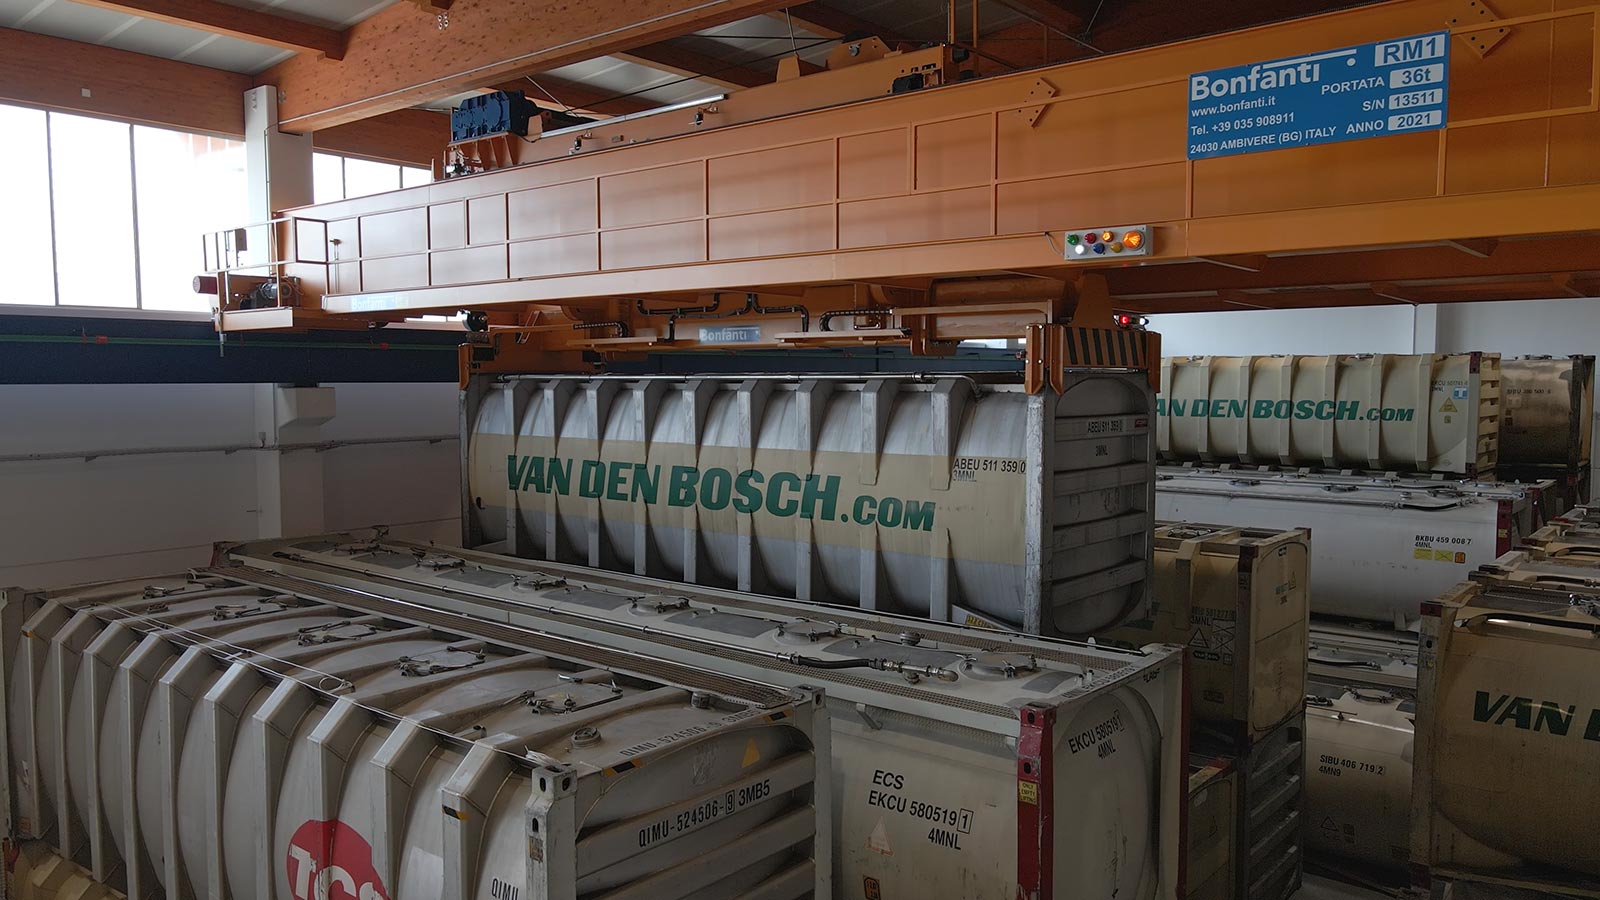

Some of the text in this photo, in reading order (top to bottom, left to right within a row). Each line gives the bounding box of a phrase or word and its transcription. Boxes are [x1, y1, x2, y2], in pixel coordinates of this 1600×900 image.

[1383, 37, 1437, 64] RM1
[1191, 64, 1320, 101] Bonfanti
[1321, 68, 1431, 96] PORTATA 36t
[1191, 95, 1276, 118] www.bonfanti.it
[1362, 91, 1436, 111] S/N 13511
[1191, 112, 1295, 136] Tel. +39 035 908911
[1345, 113, 1431, 134] ANNO 2021
[1190, 126, 1336, 154] 24030 AMBIVERE (BG) ITALY
[699, 328, 747, 341] Bonfanti
[1156, 398, 1188, 416] AN
[1191, 398, 1248, 418] DEN
[953, 459, 980, 471] ABEU
[982, 460, 998, 471] 511
[1001, 461, 1018, 473] 359
[508, 455, 573, 495] VAN
[579, 459, 661, 505] DEN
[1436, 536, 1449, 544] 459
[1473, 691, 1576, 736] VAN
[1068, 729, 1096, 754] EKCU
[1320, 755, 1339, 766] SIBU
[1340, 759, 1356, 769] 406
[1360, 763, 1375, 772] 719
[873, 770, 904, 790] ECS
[738, 780, 770, 806] 3MB5
[868, 790, 907, 813] EKCU
[928, 828, 962, 850] 4MNL
